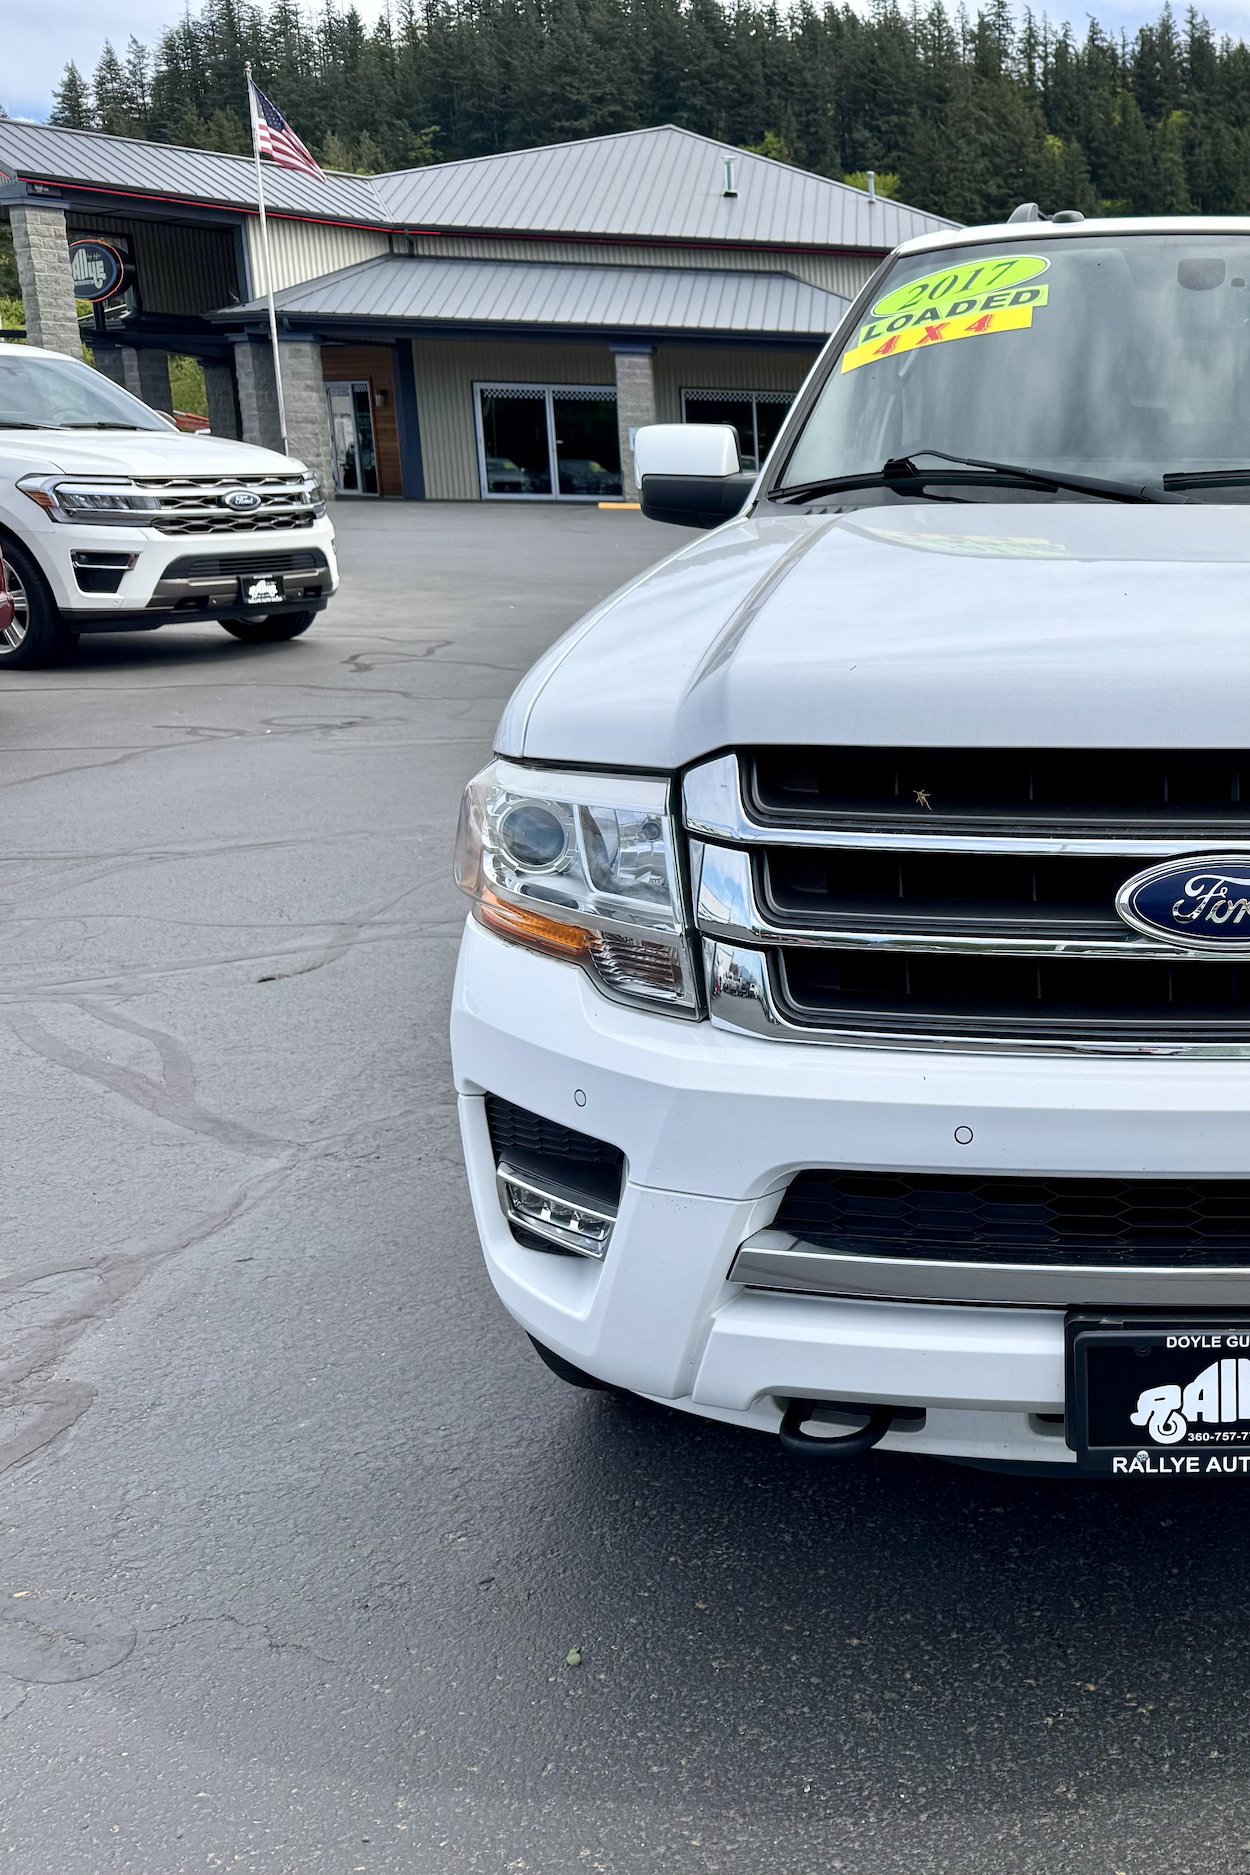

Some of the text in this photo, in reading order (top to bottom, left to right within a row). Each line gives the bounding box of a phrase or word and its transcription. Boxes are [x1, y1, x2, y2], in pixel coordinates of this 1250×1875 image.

[896, 259, 1019, 311] 2017
[860, 288, 1041, 344] LOADED
[873, 314, 994, 356] 4 X 4
[1166, 1335, 1222, 1349] DOYLE
[1112, 1456, 1200, 1473] RALLYE
